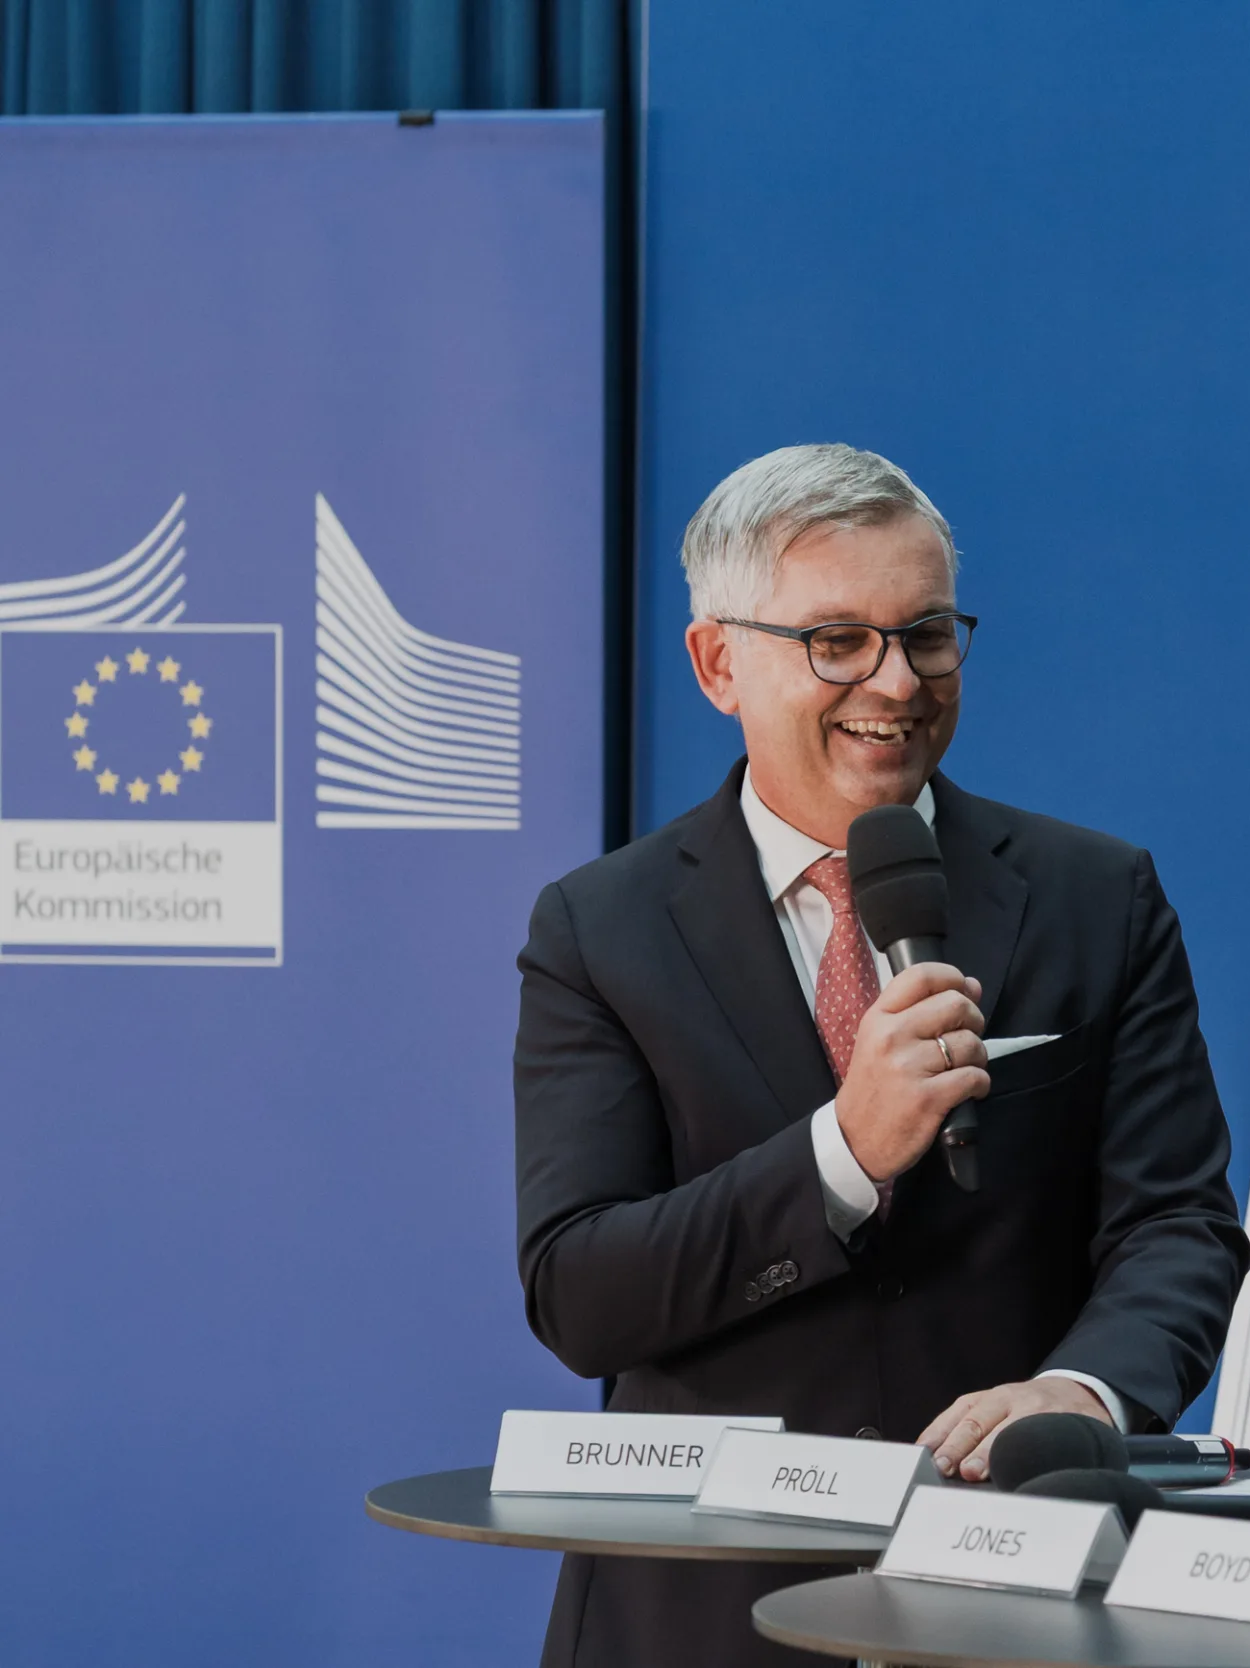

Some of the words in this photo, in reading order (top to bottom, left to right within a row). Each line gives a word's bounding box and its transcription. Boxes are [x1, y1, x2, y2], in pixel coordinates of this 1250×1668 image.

[14, 839, 223, 878] Europäische
[14, 888, 224, 921] Kommission
[566, 1442, 704, 1468] BRUNNER
[771, 1465, 838, 1495] PRÖLL
[951, 1524, 1027, 1556] JONES
